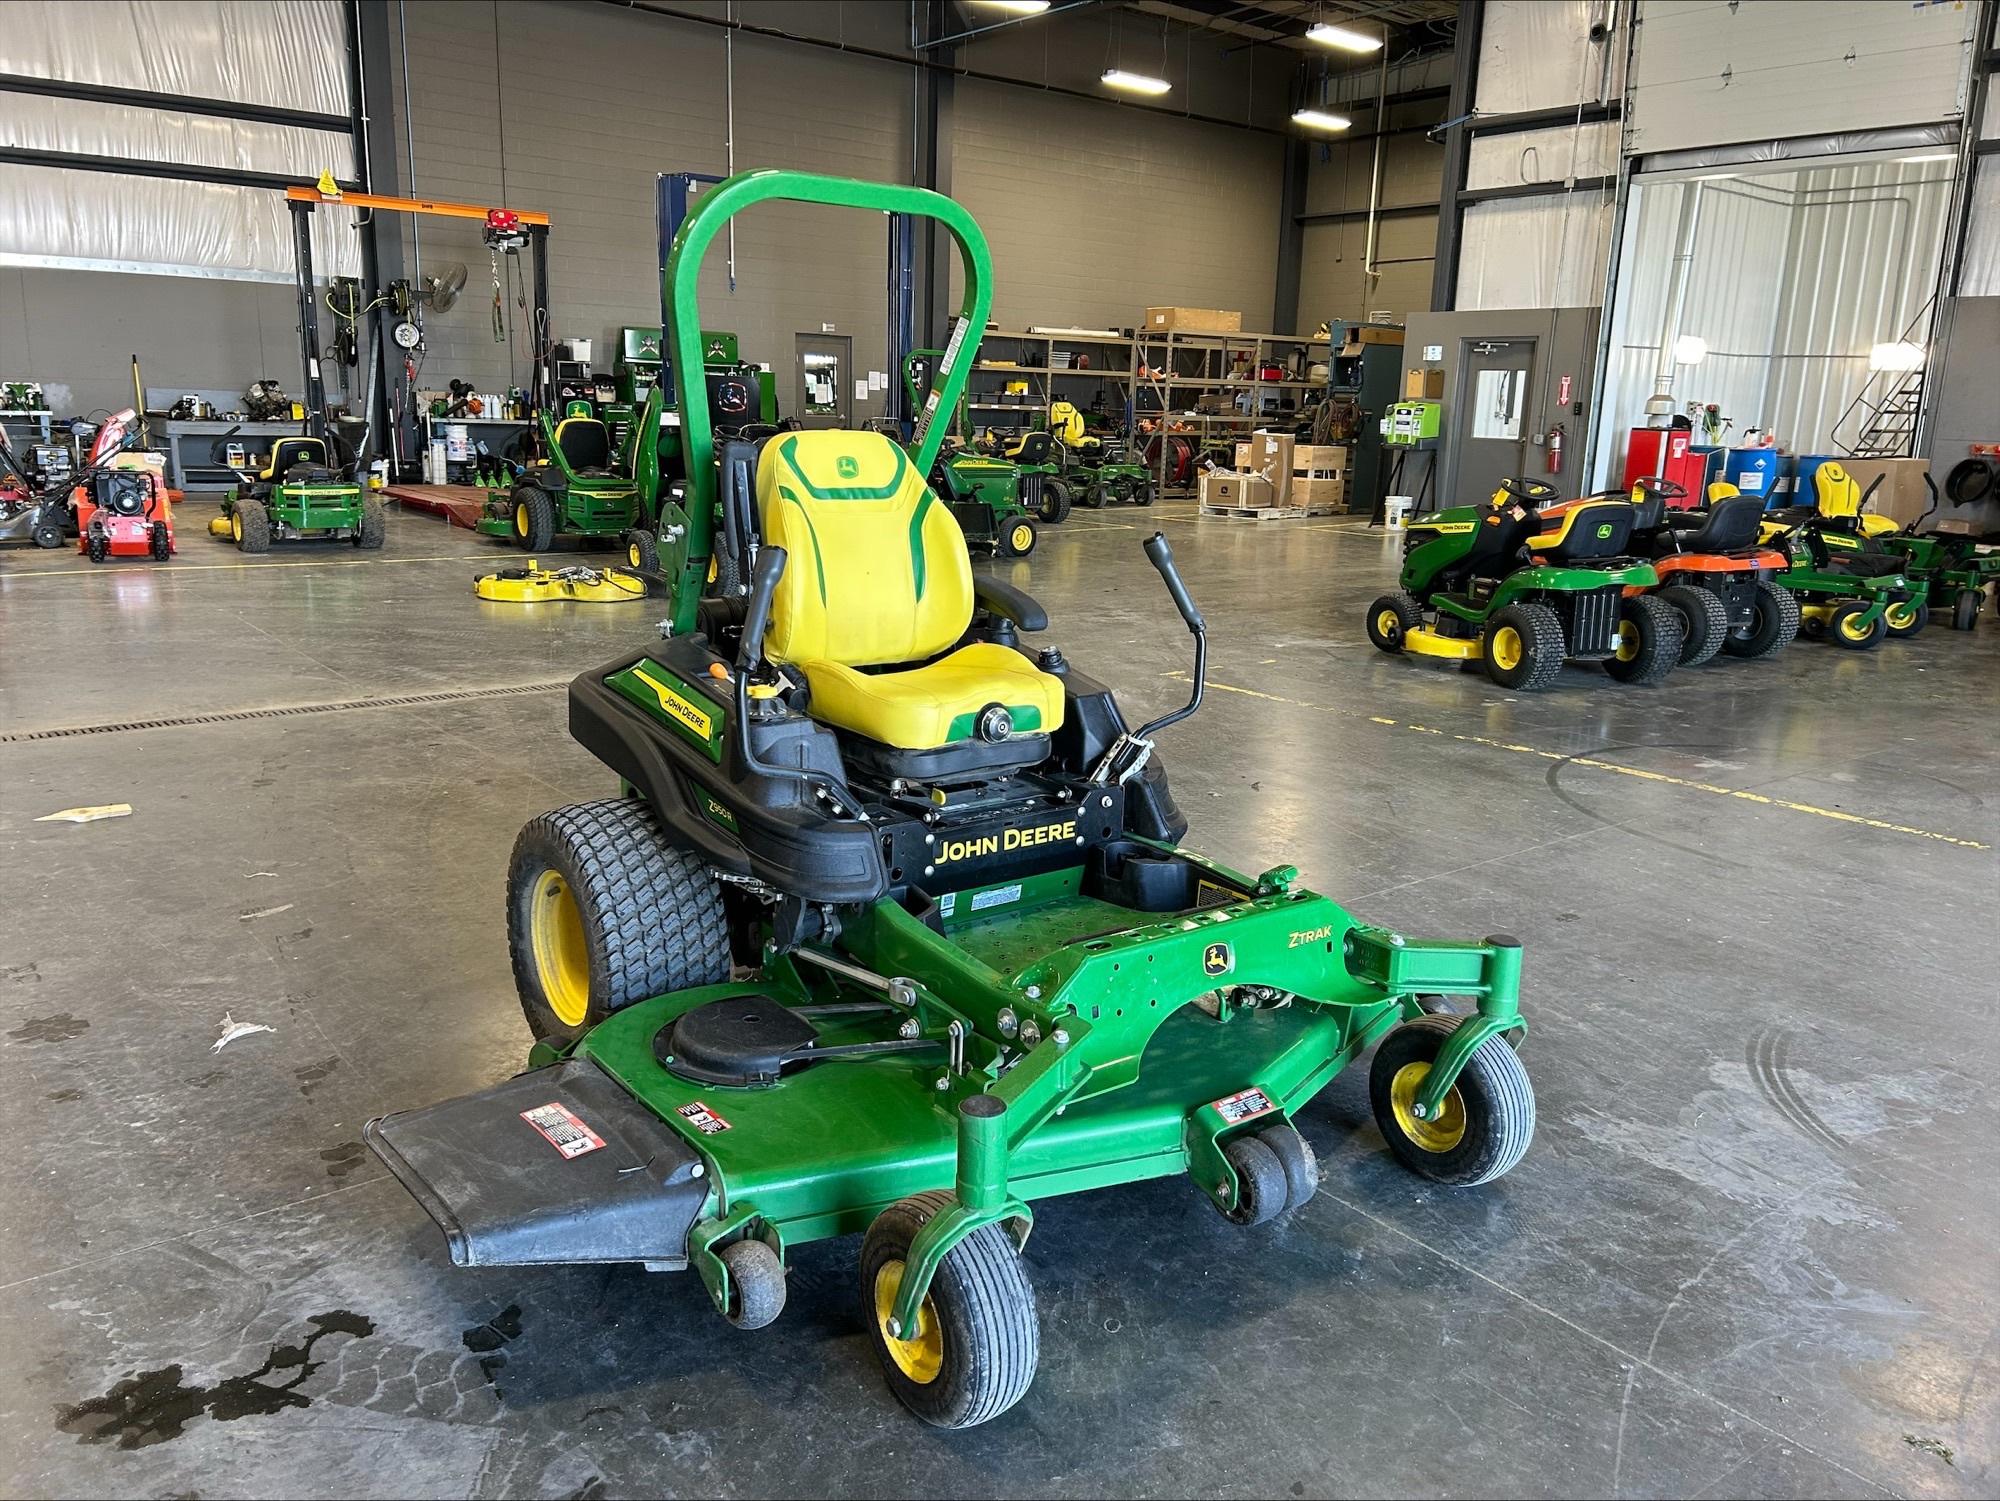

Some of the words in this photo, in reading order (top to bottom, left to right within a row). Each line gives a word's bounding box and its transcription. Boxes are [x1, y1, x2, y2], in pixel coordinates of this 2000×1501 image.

[664, 695, 683, 715] JOHN
[682, 706, 705, 729] DEERE
[708, 798, 733, 823] Z950R
[934, 835, 998, 864] JOHN
[1003, 820, 1076, 850] DEERE
[1288, 924, 1333, 949] ZTRAK
